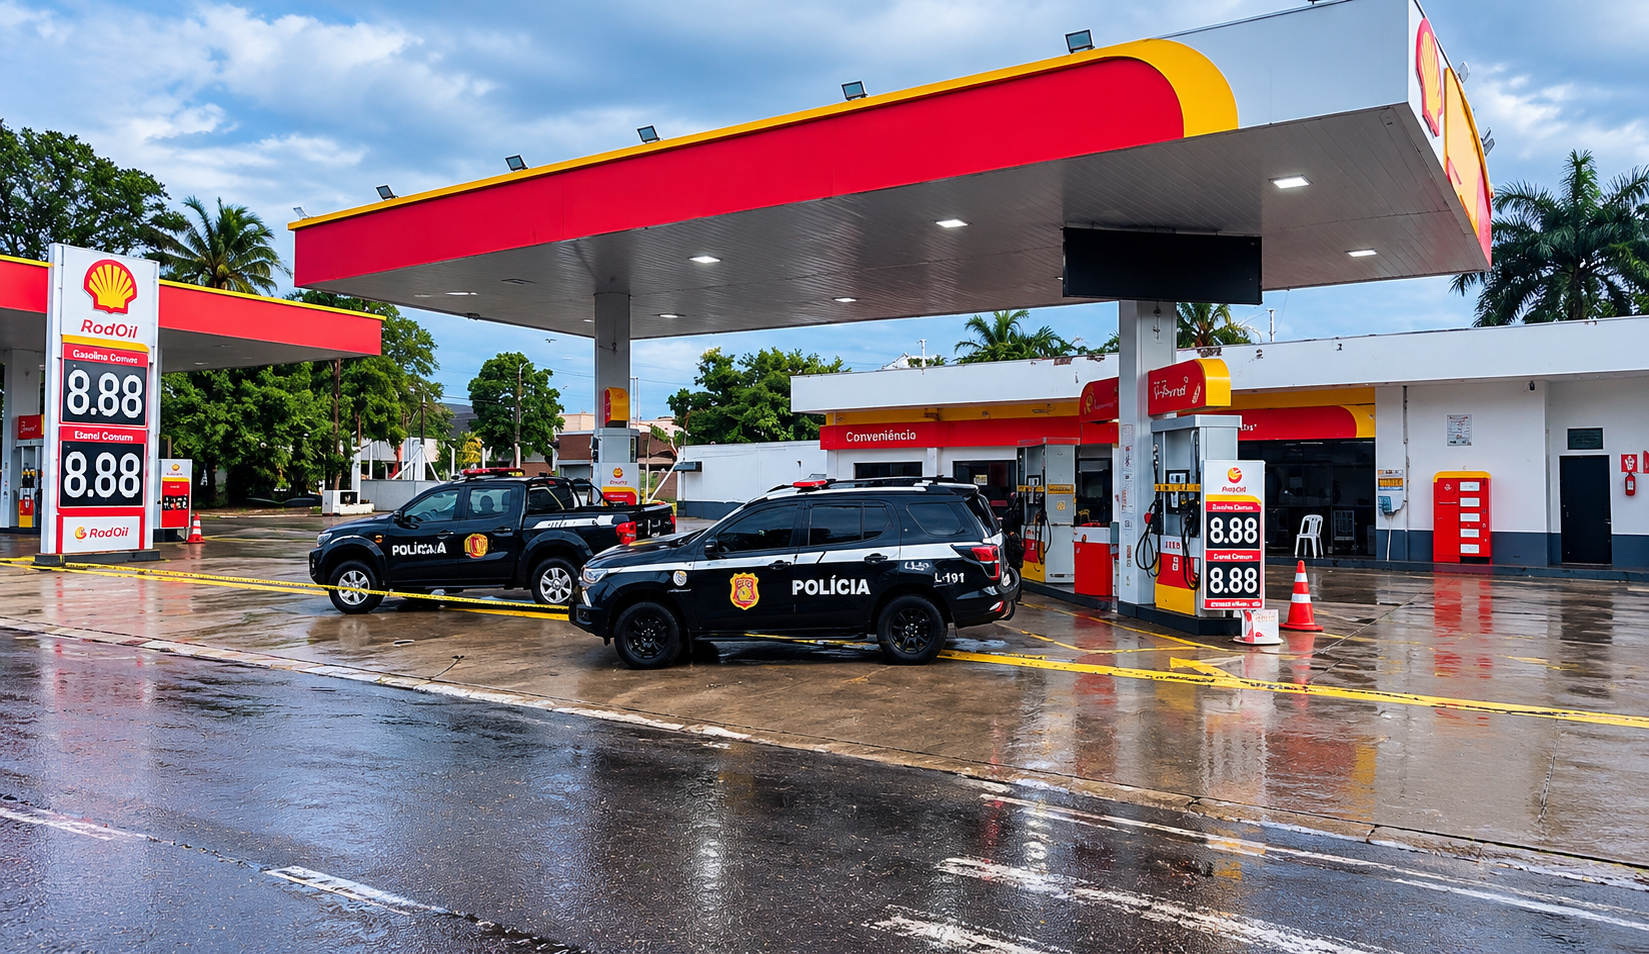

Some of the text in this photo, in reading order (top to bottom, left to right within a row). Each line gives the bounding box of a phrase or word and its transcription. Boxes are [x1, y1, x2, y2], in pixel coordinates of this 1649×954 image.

[80, 318, 139, 339] RodOil
[66, 369, 143, 419] 8.88
[63, 451, 141, 498] 8.88
[89, 526, 129, 538] RodOil
[1209, 516, 1258, 544] 8.88
[791, 574, 871, 596] POLÍCIA
[1209, 566, 1258, 594] 8.88
